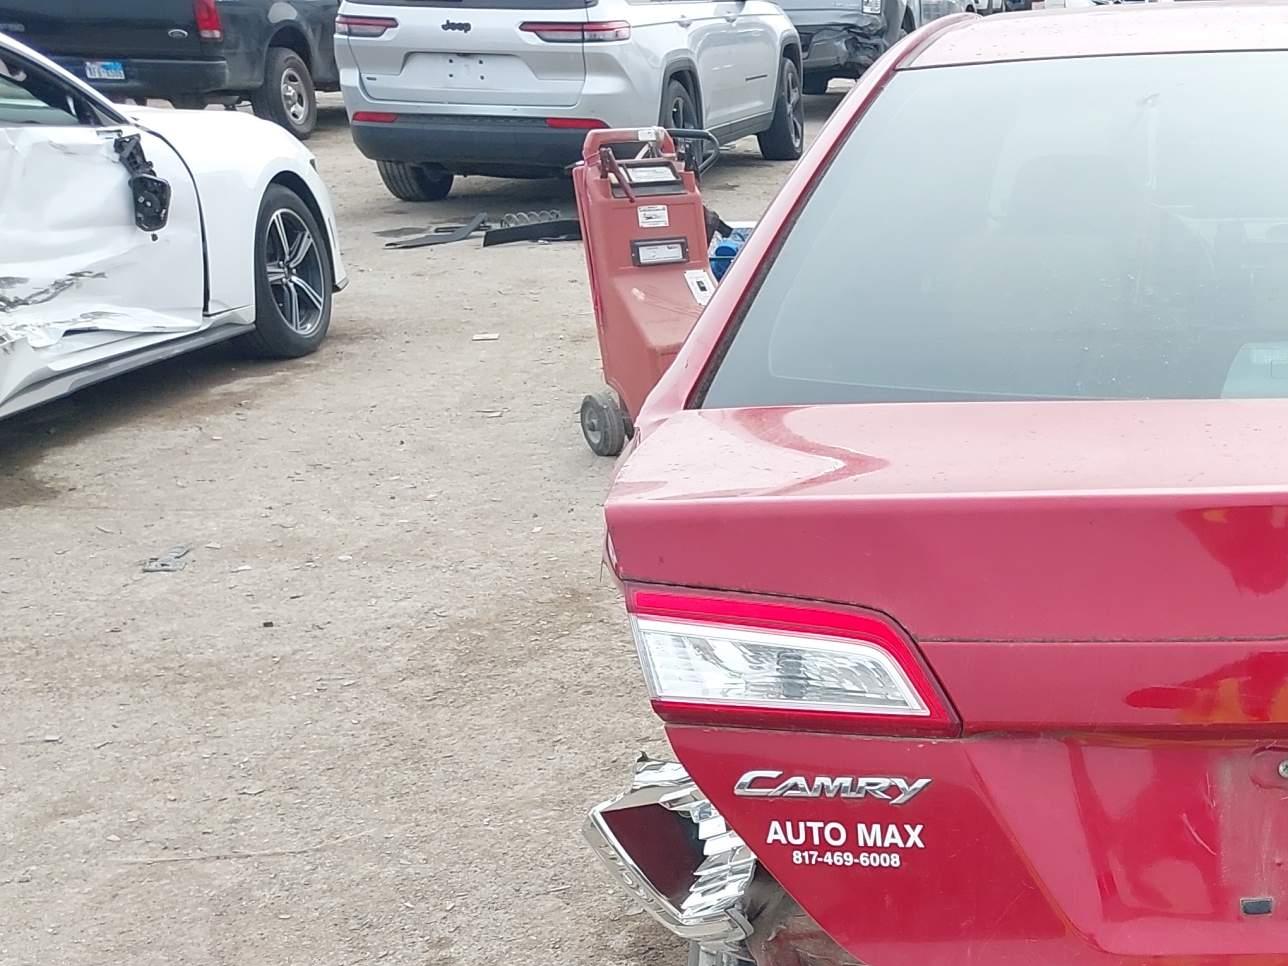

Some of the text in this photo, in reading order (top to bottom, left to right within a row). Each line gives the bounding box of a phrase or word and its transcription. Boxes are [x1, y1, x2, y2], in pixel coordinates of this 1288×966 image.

[441, 19, 472, 34] Jeep
[733, 770, 932, 806] CAMRY
[766, 820, 925, 848] AUTO MAX
[792, 850, 901, 868] 817-469-6008
